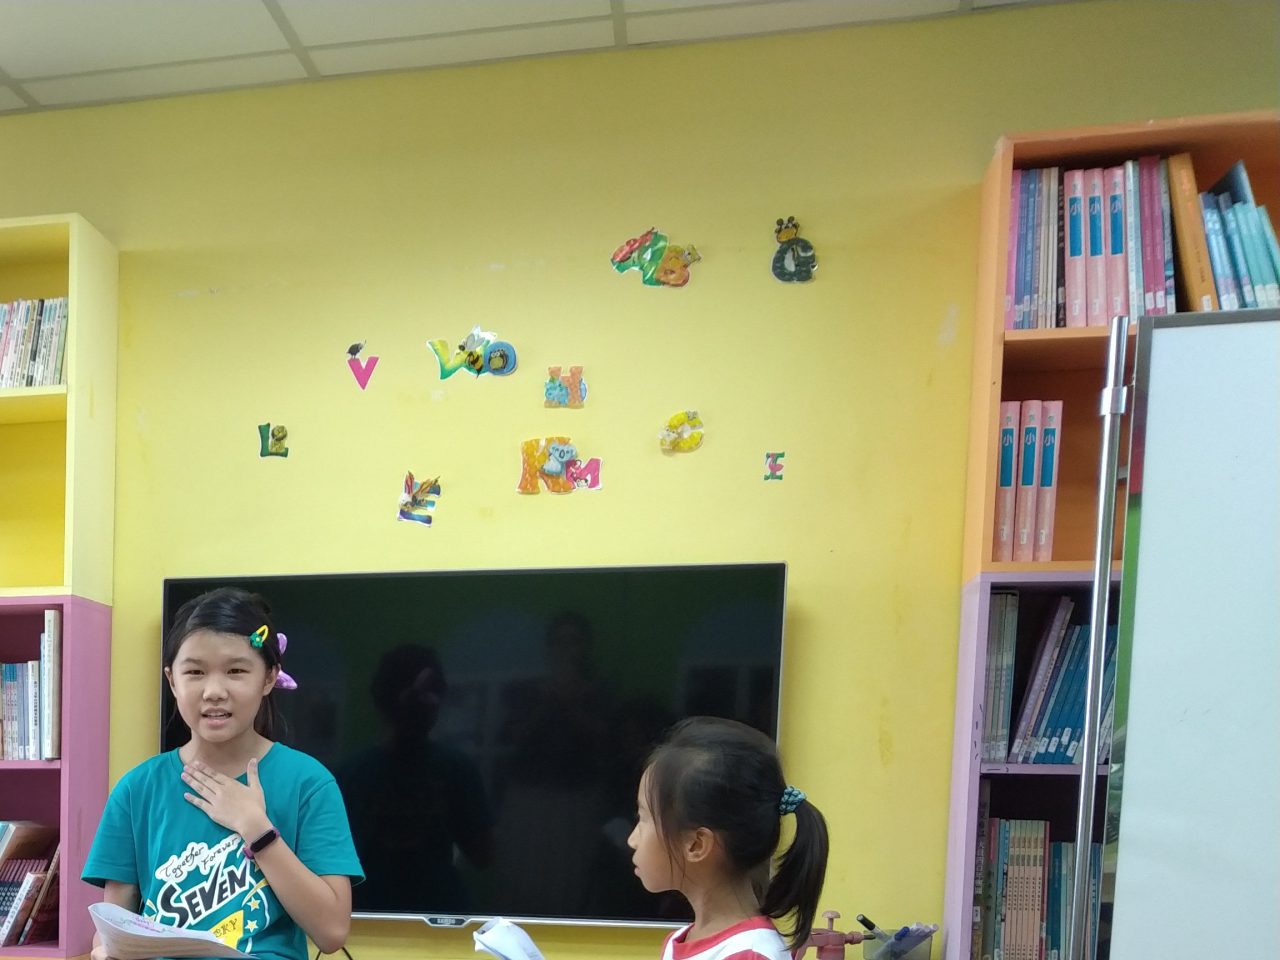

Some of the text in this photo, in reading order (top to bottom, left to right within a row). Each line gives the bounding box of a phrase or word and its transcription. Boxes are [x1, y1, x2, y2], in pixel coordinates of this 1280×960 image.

[347, 357, 380, 391] V
[258, 423, 289, 457] L
[160, 847, 204, 878] Together
[201, 837, 238, 870] Forever
[160, 860, 249, 929] SEVEN
